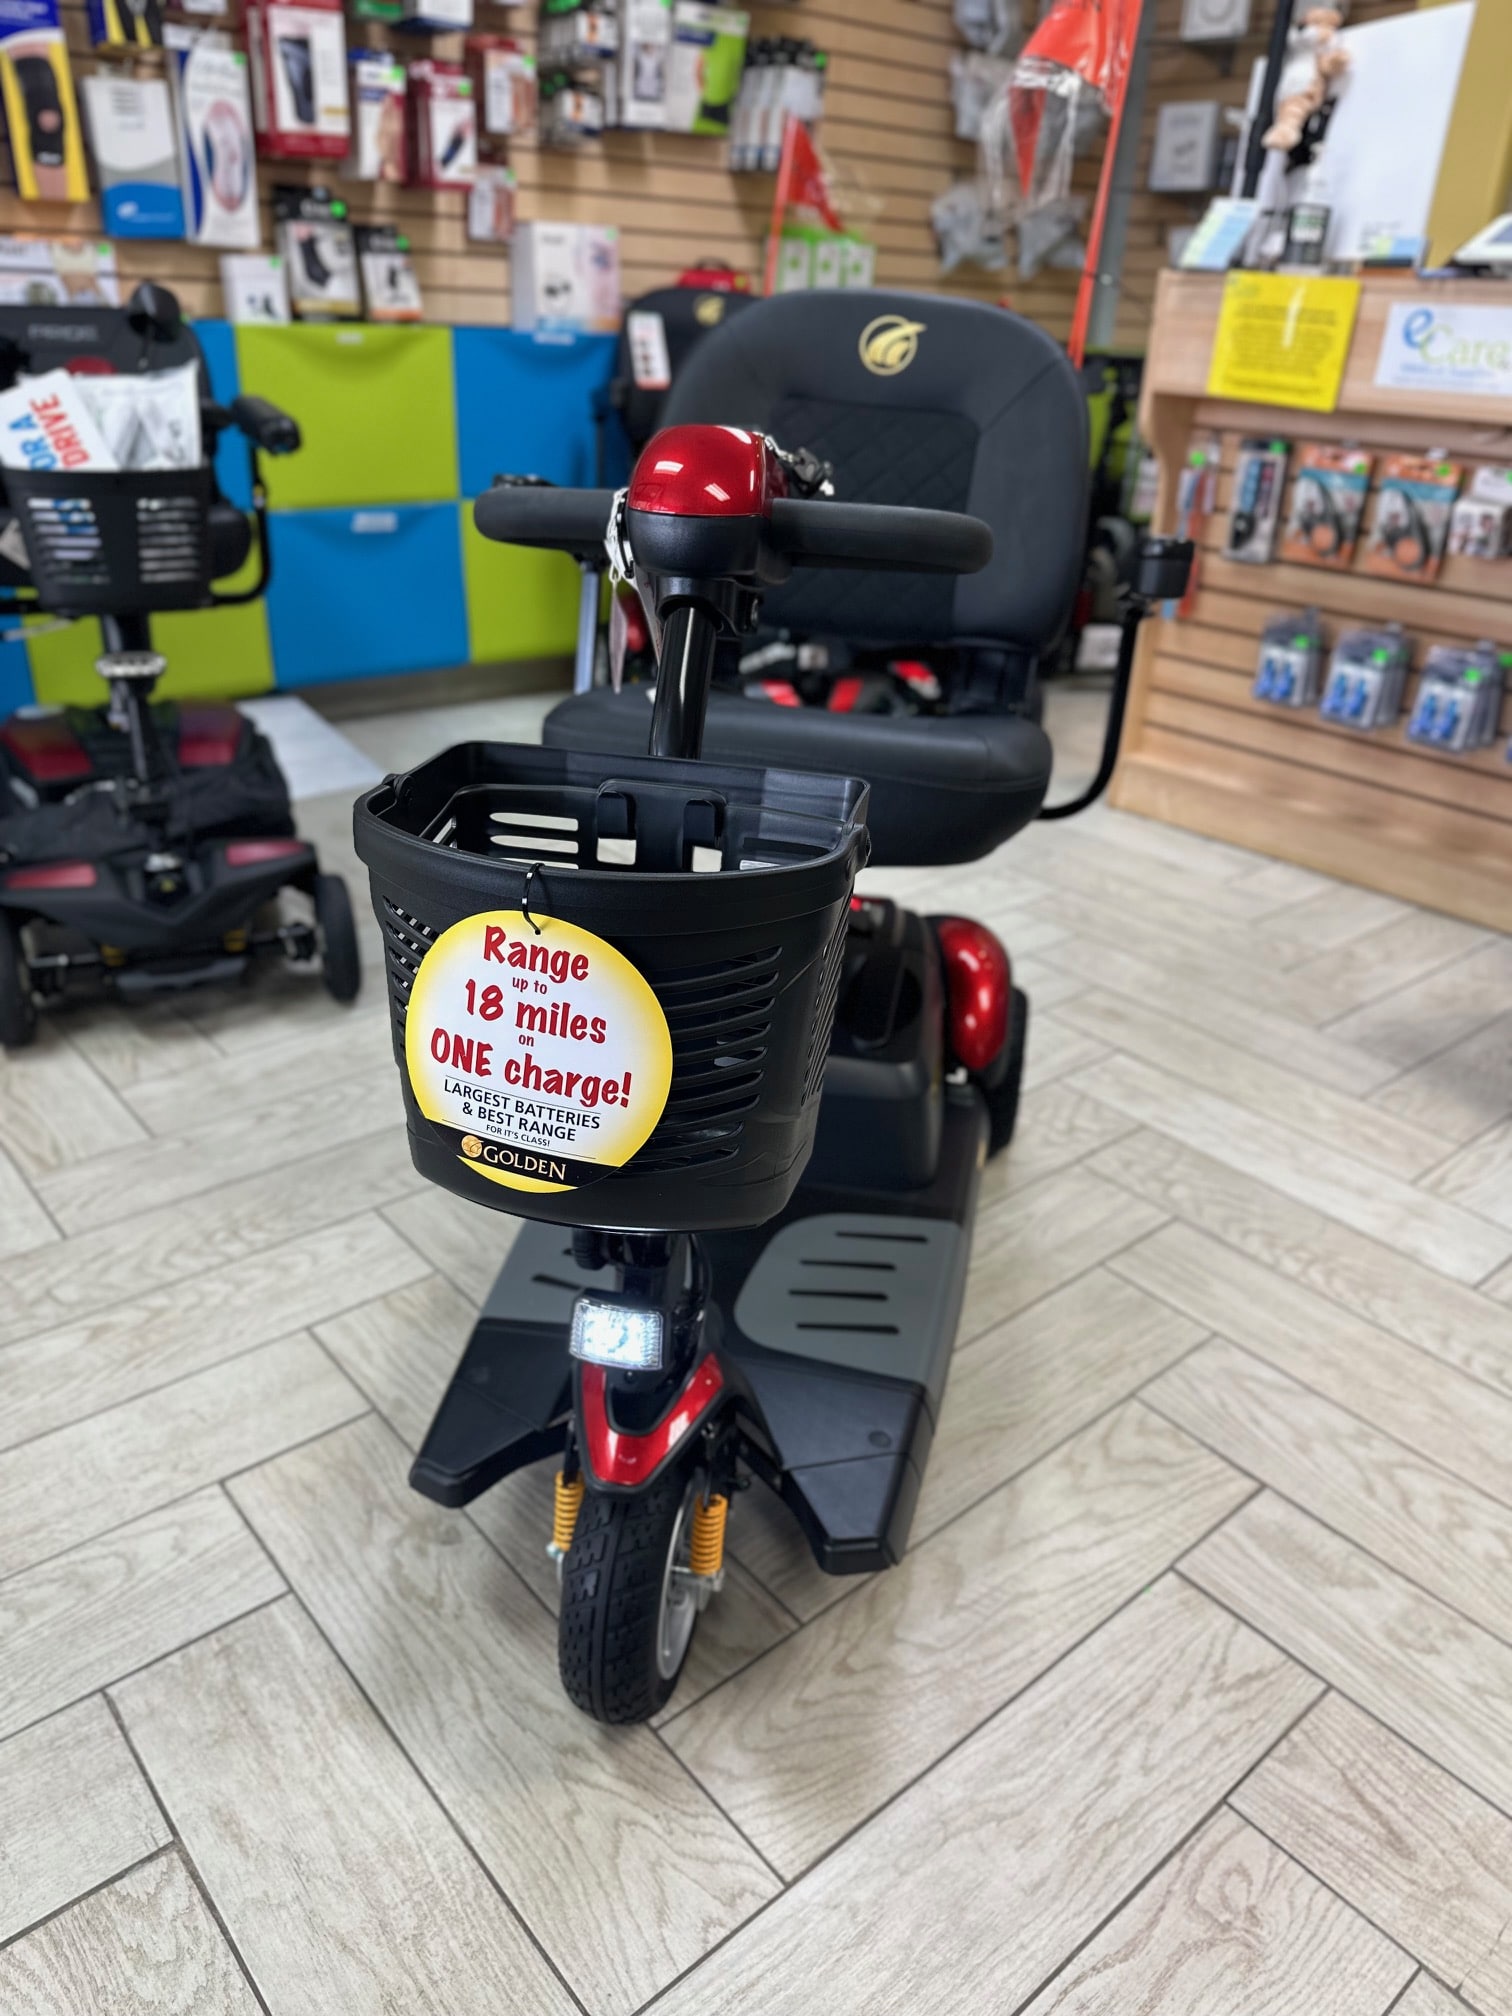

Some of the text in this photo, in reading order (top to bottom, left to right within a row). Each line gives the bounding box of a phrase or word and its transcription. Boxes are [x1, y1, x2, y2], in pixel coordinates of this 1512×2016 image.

[29, 392, 91, 470] DRIVE
[483, 925, 589, 984] Range
[512, 977, 548, 995] up to
[465, 979, 607, 1044] 18 miles
[518, 1035, 535, 1048] on
[430, 1028, 632, 1108] ONE charge!
[444, 1079, 600, 1129] LARGEST BATTERIES
[462, 1102, 576, 1142] & BEST RANGE
[486, 1124, 550, 1147] FOR IT'S CLASS!
[483, 1145, 567, 1181] GOLDEN
